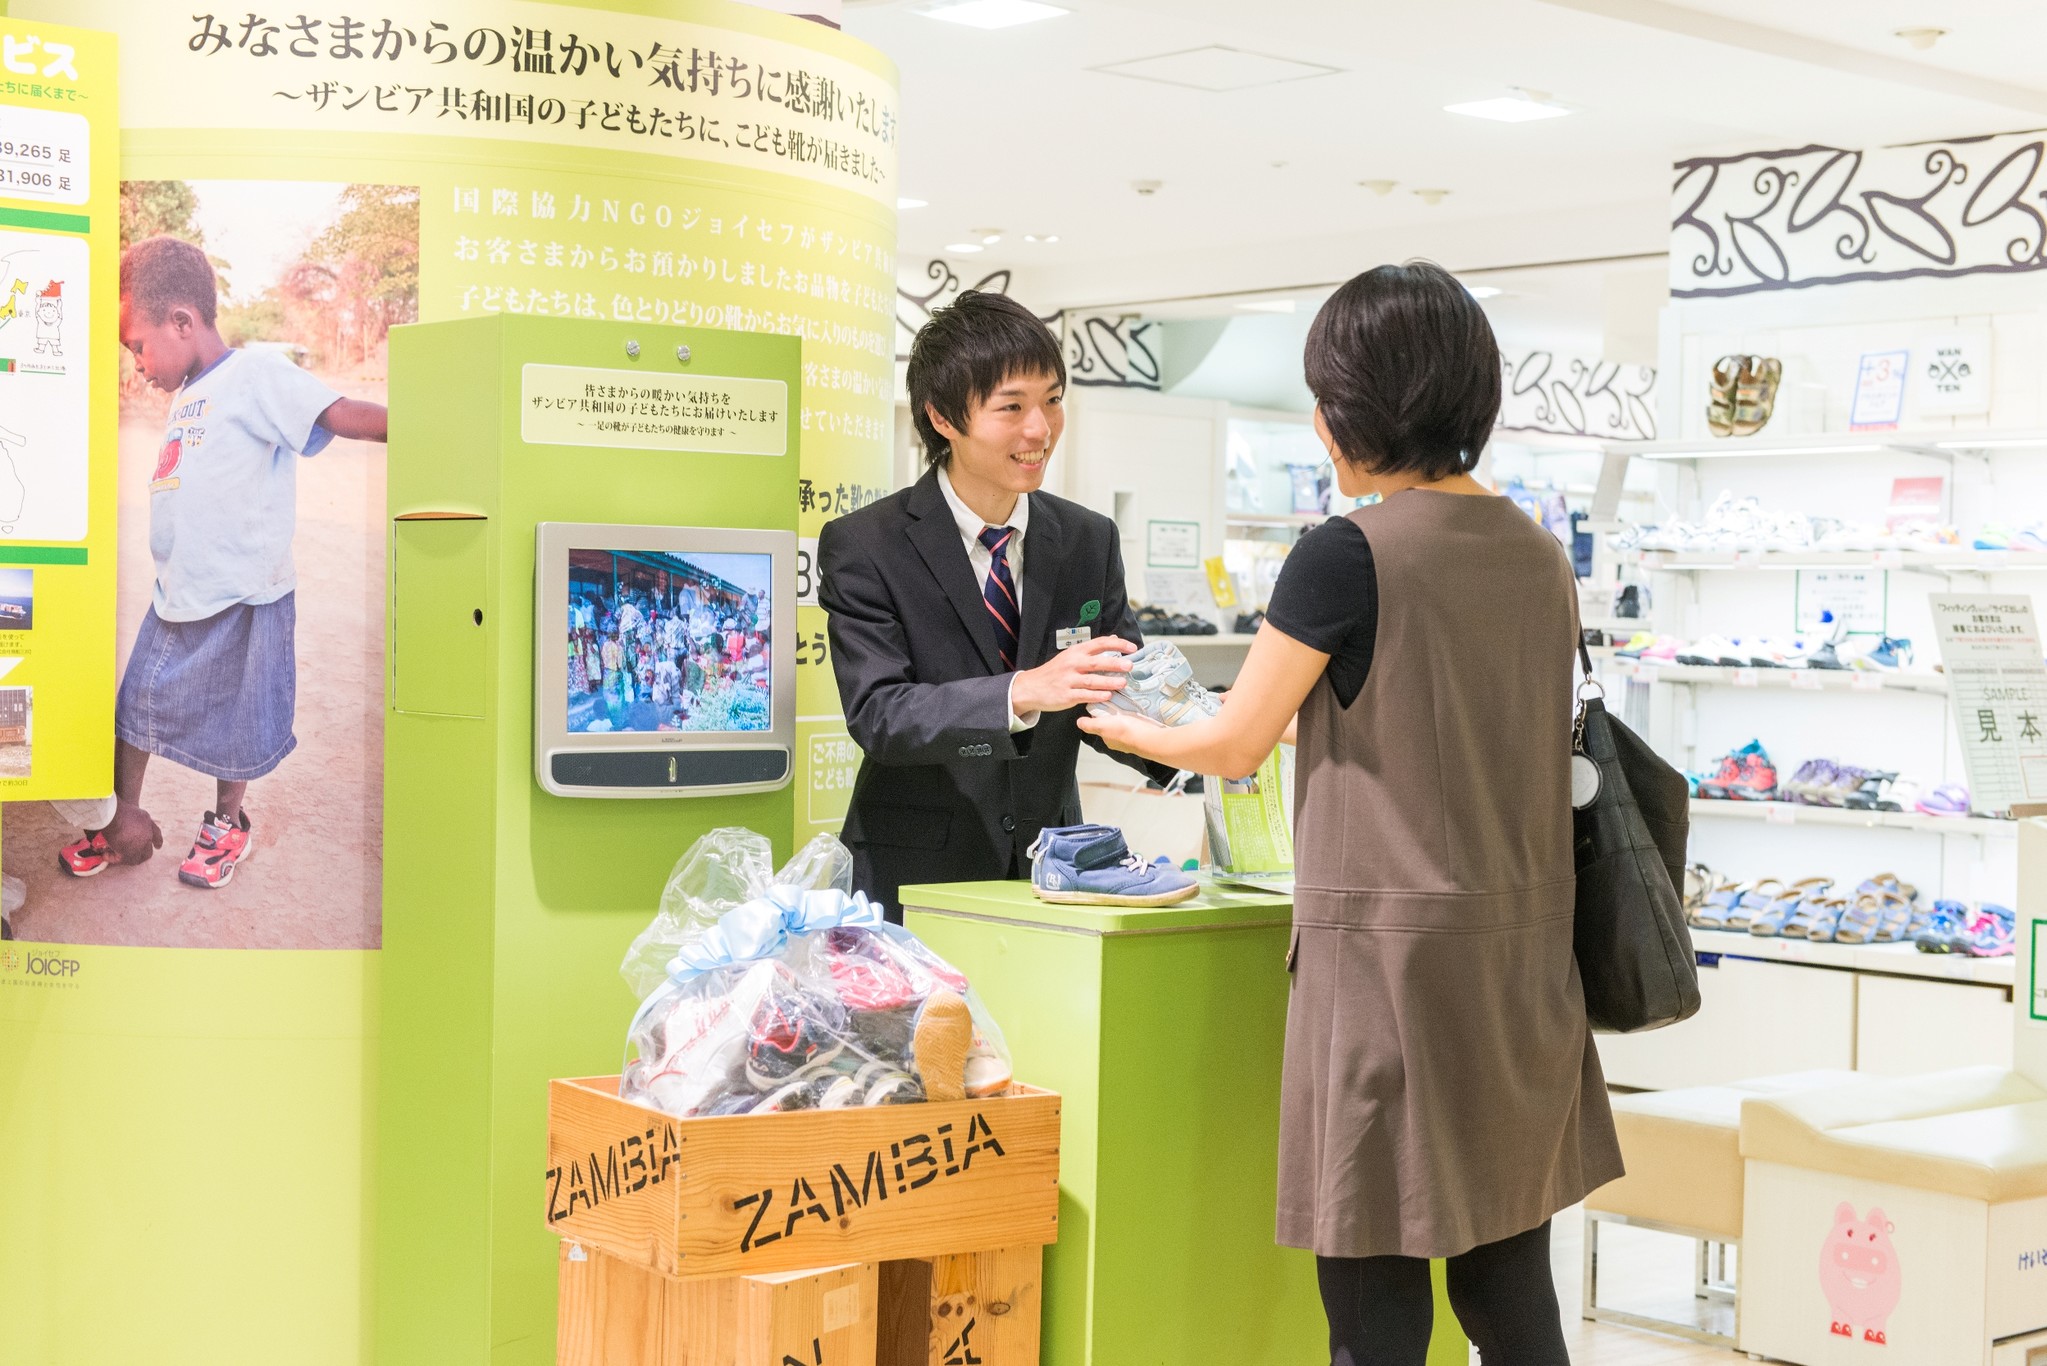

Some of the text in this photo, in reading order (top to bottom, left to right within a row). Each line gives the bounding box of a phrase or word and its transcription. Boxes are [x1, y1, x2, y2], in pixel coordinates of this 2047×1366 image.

[0, 141, 71, 163] 9,265 足
[59, 176, 71, 191] 足
[584, 383, 731, 406] 皆さまからの暖かい気持ちを
[531, 397, 778, 423] ザンビア共和国の子どもたちにお届けいたします
[813, 741, 855, 764] ご不用の
[26, 951, 80, 977] JOICFP
[546, 1122, 681, 1223] ZAMBIA
[733, 1113, 1006, 1254] ZAMBIA
